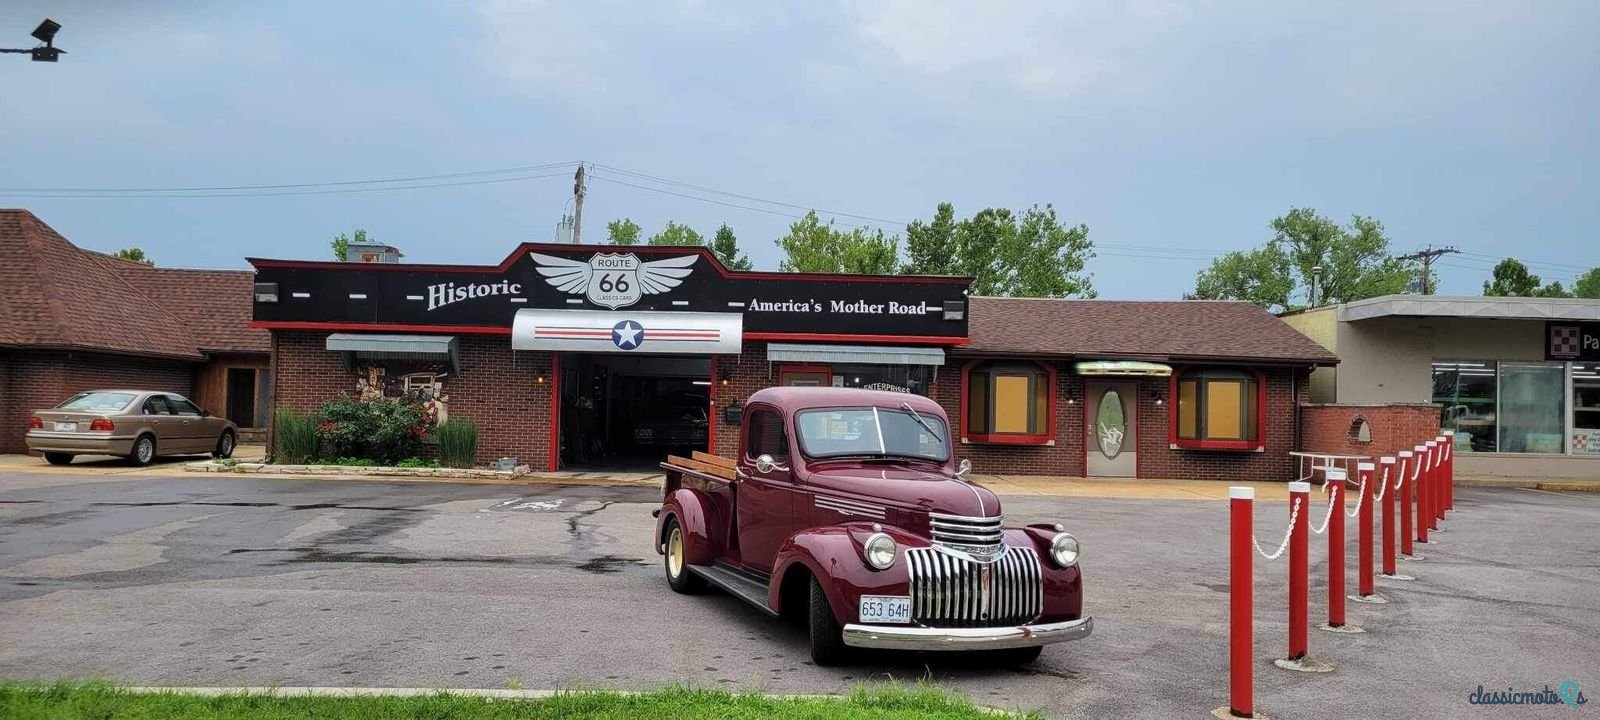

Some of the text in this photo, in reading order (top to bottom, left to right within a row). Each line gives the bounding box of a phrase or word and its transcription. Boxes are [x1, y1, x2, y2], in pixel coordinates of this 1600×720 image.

[598, 259, 631, 268] ROUTE
[599, 273, 630, 293] 66
[427, 279, 522, 311] Historic
[748, 298, 926, 315] America's Mother Road
[862, 601, 909, 618] 653 64H
